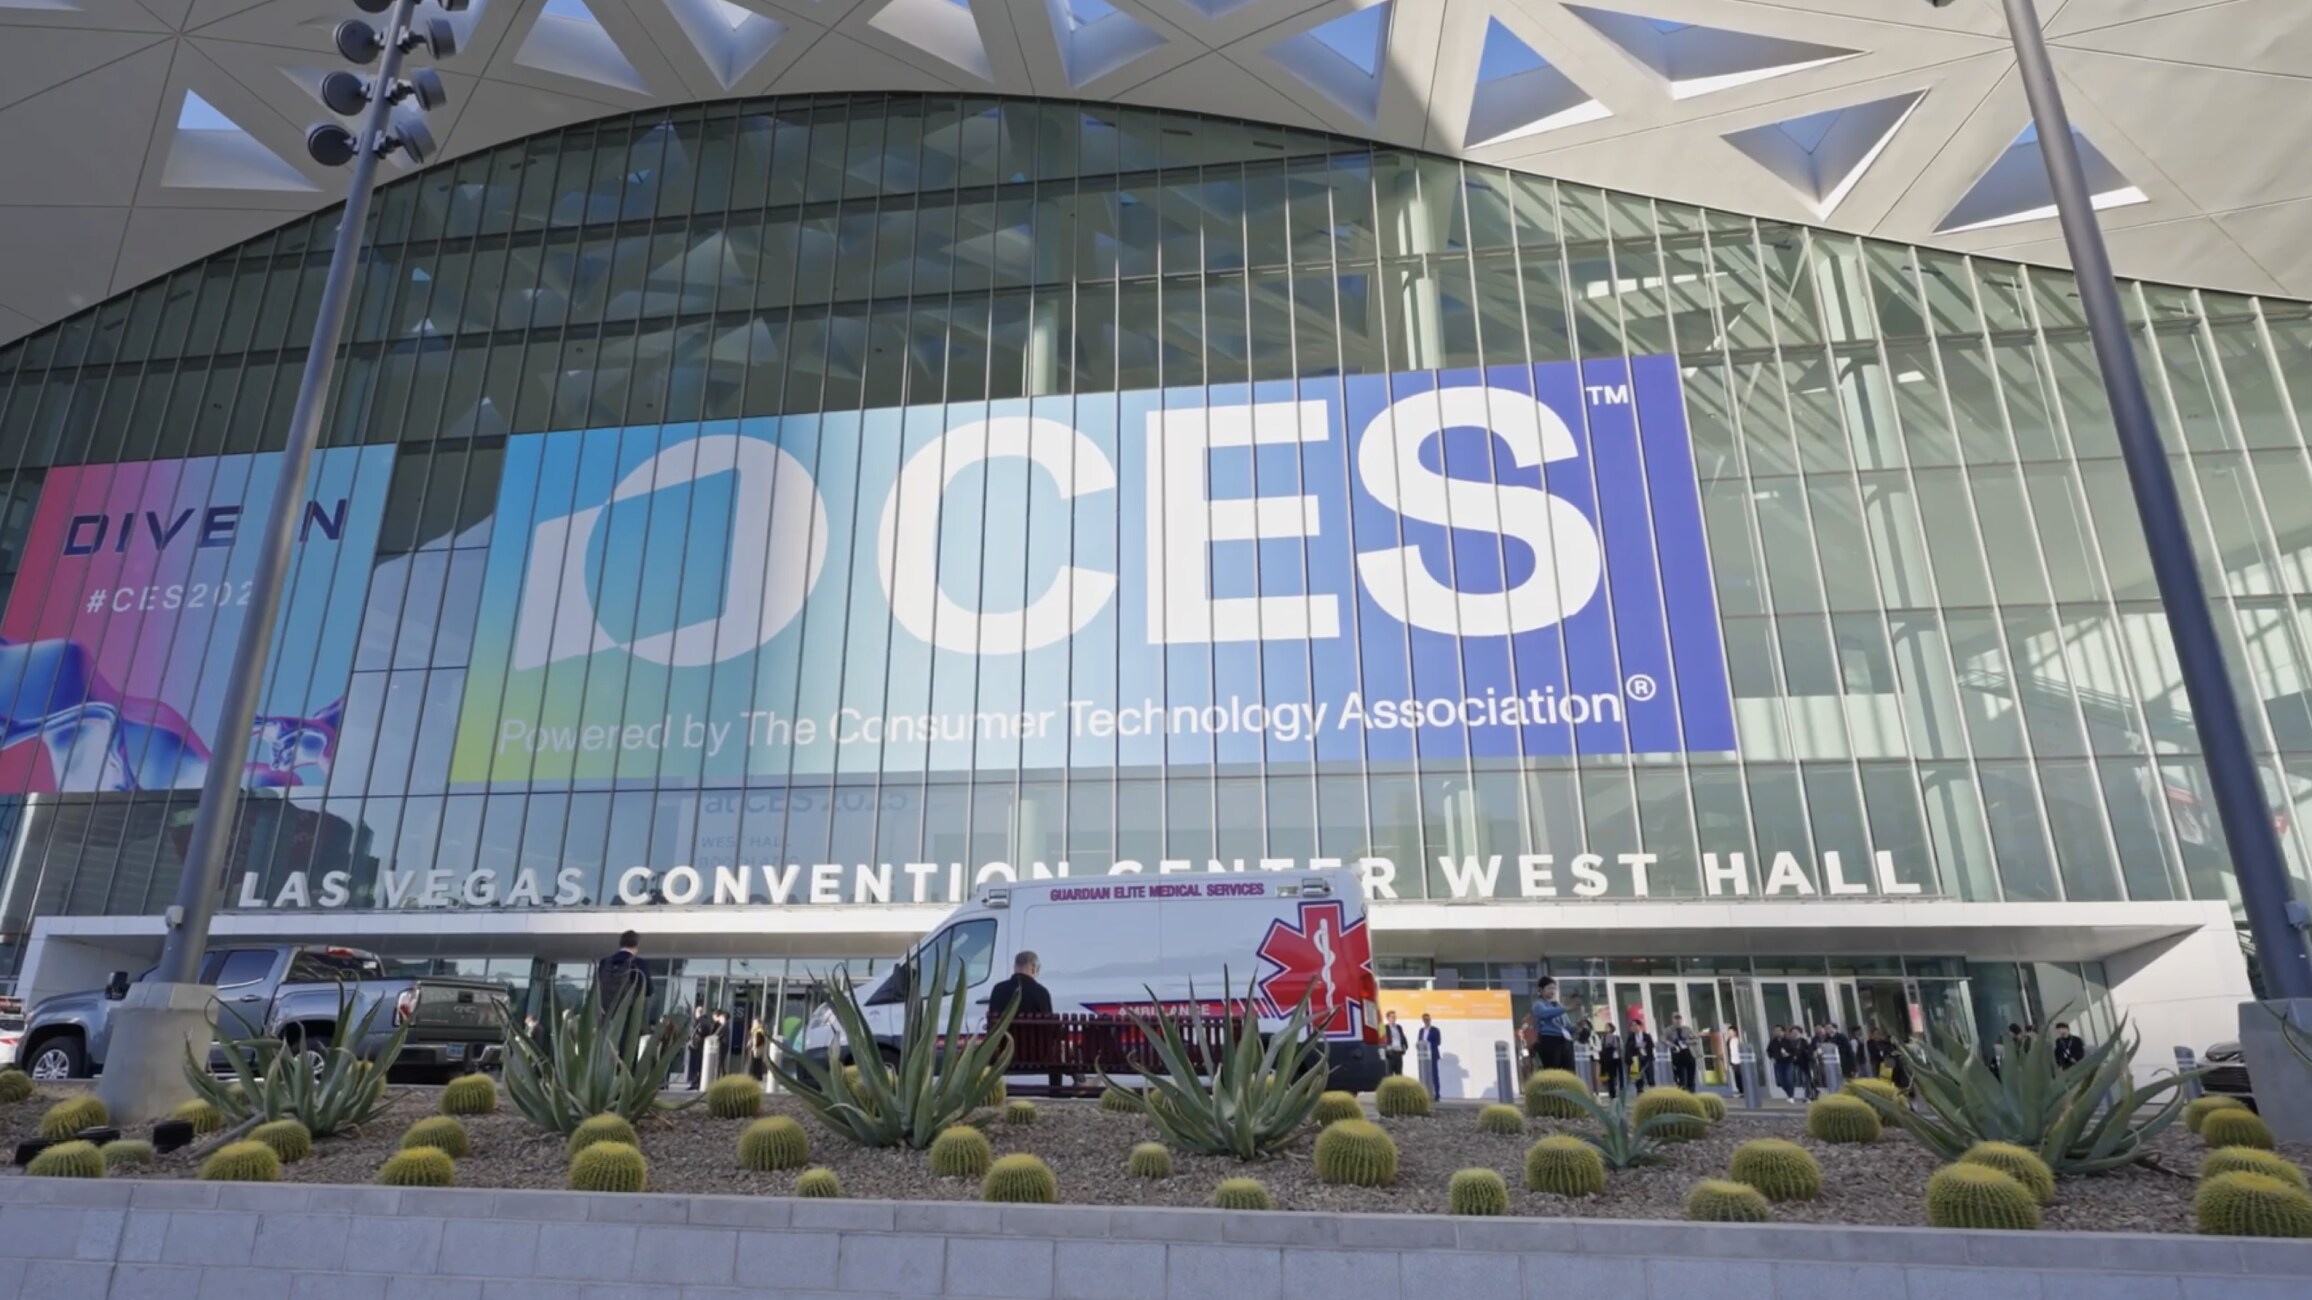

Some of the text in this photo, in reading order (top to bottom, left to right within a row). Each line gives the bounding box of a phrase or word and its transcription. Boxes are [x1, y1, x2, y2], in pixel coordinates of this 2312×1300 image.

[62, 505, 244, 556] DIVE
[86, 580, 255, 613] #CES202
[499, 714, 669, 754] Powered
[682, 711, 731, 756] by
[740, 709, 815, 747] The
[829, 706, 1056, 744] Consumer
[1066, 694, 1326, 742] Technology
[238, 867, 351, 908] LAS
[381, 866, 585, 908] VEGAS
[1439, 852, 1657, 898] WEST
[1702, 850, 1921, 897] HALL
[1050, 883, 1264, 901] GUARDIAN ELITE MEDICAL SERVICES
